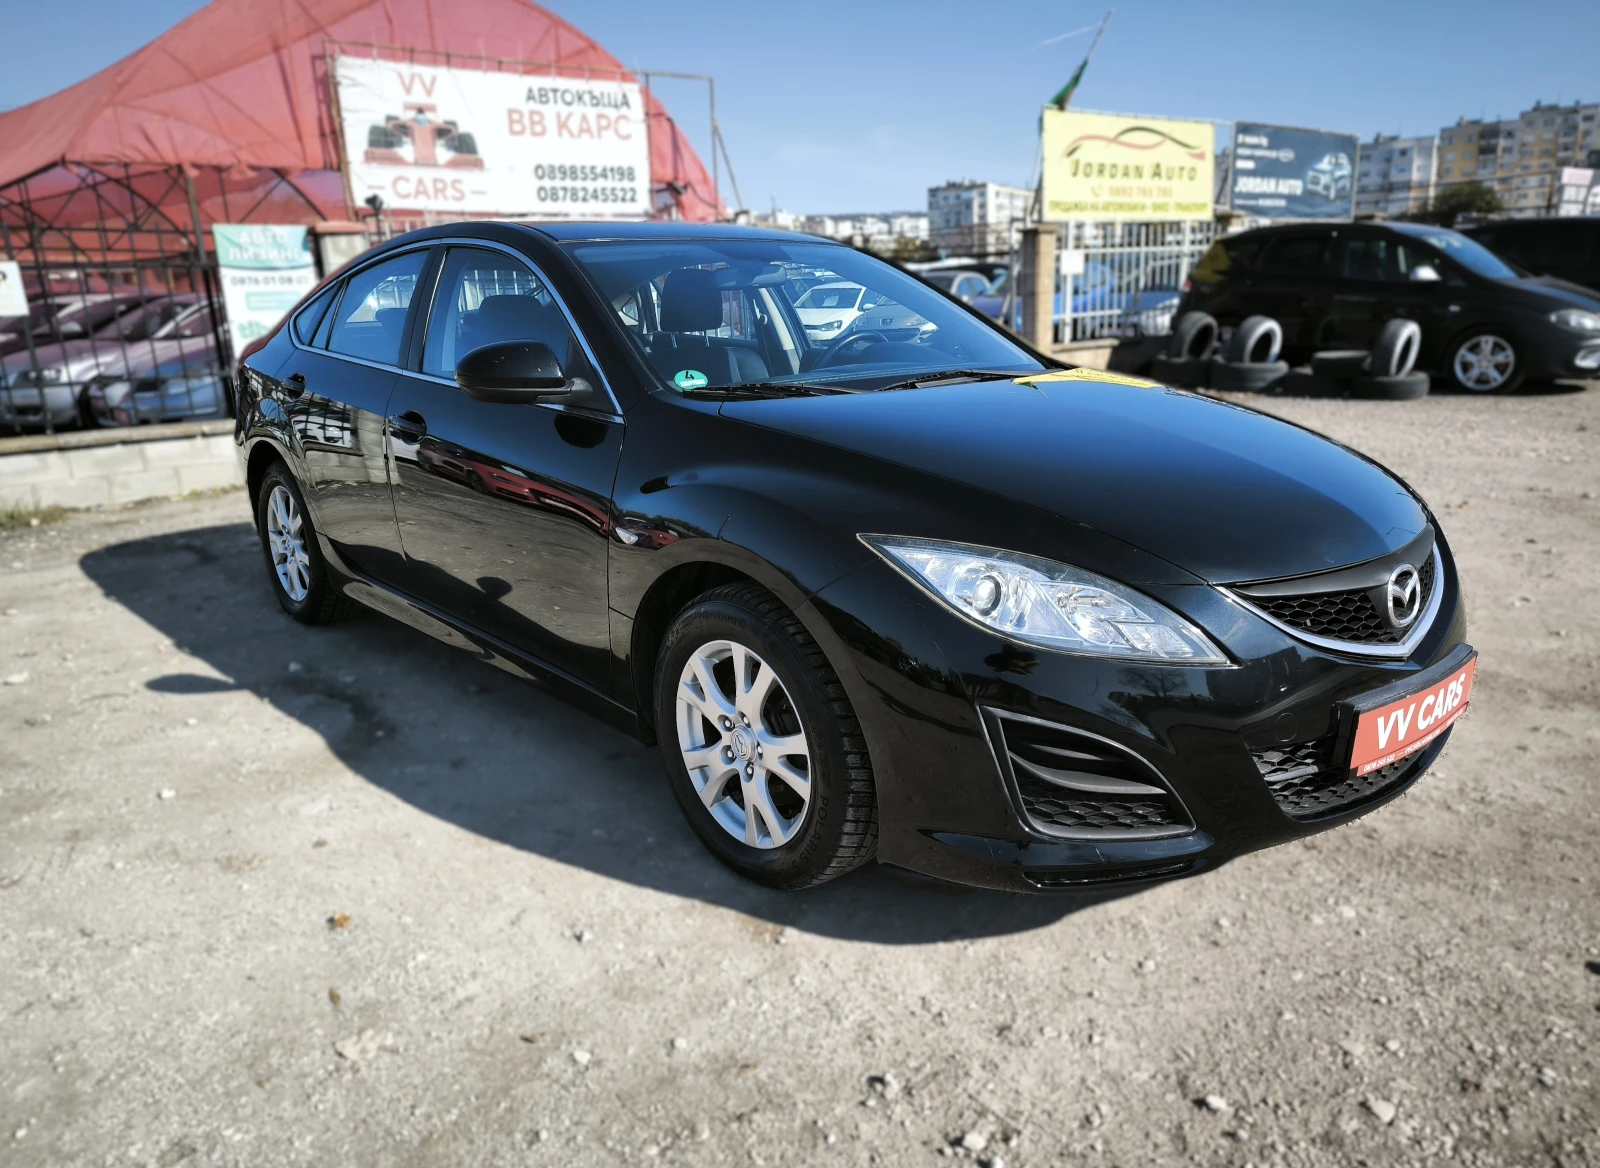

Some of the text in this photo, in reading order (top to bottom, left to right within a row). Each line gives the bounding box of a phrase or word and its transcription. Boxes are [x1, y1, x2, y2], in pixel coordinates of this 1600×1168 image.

[399, 72, 437, 98] VV
[525, 86, 632, 110] АВТОКЪЩА
[556, 112, 633, 141] КАРС
[534, 164, 636, 183] 0898554198
[1234, 176, 1304, 196] JORDAN AUTO
[392, 176, 466, 202] CARS
[536, 186, 638, 204] 0878245522
[686, 371, 695, 379] 4
[1377, 673, 1466, 750] VV CARS
[799, 794, 829, 864] POLARIS
